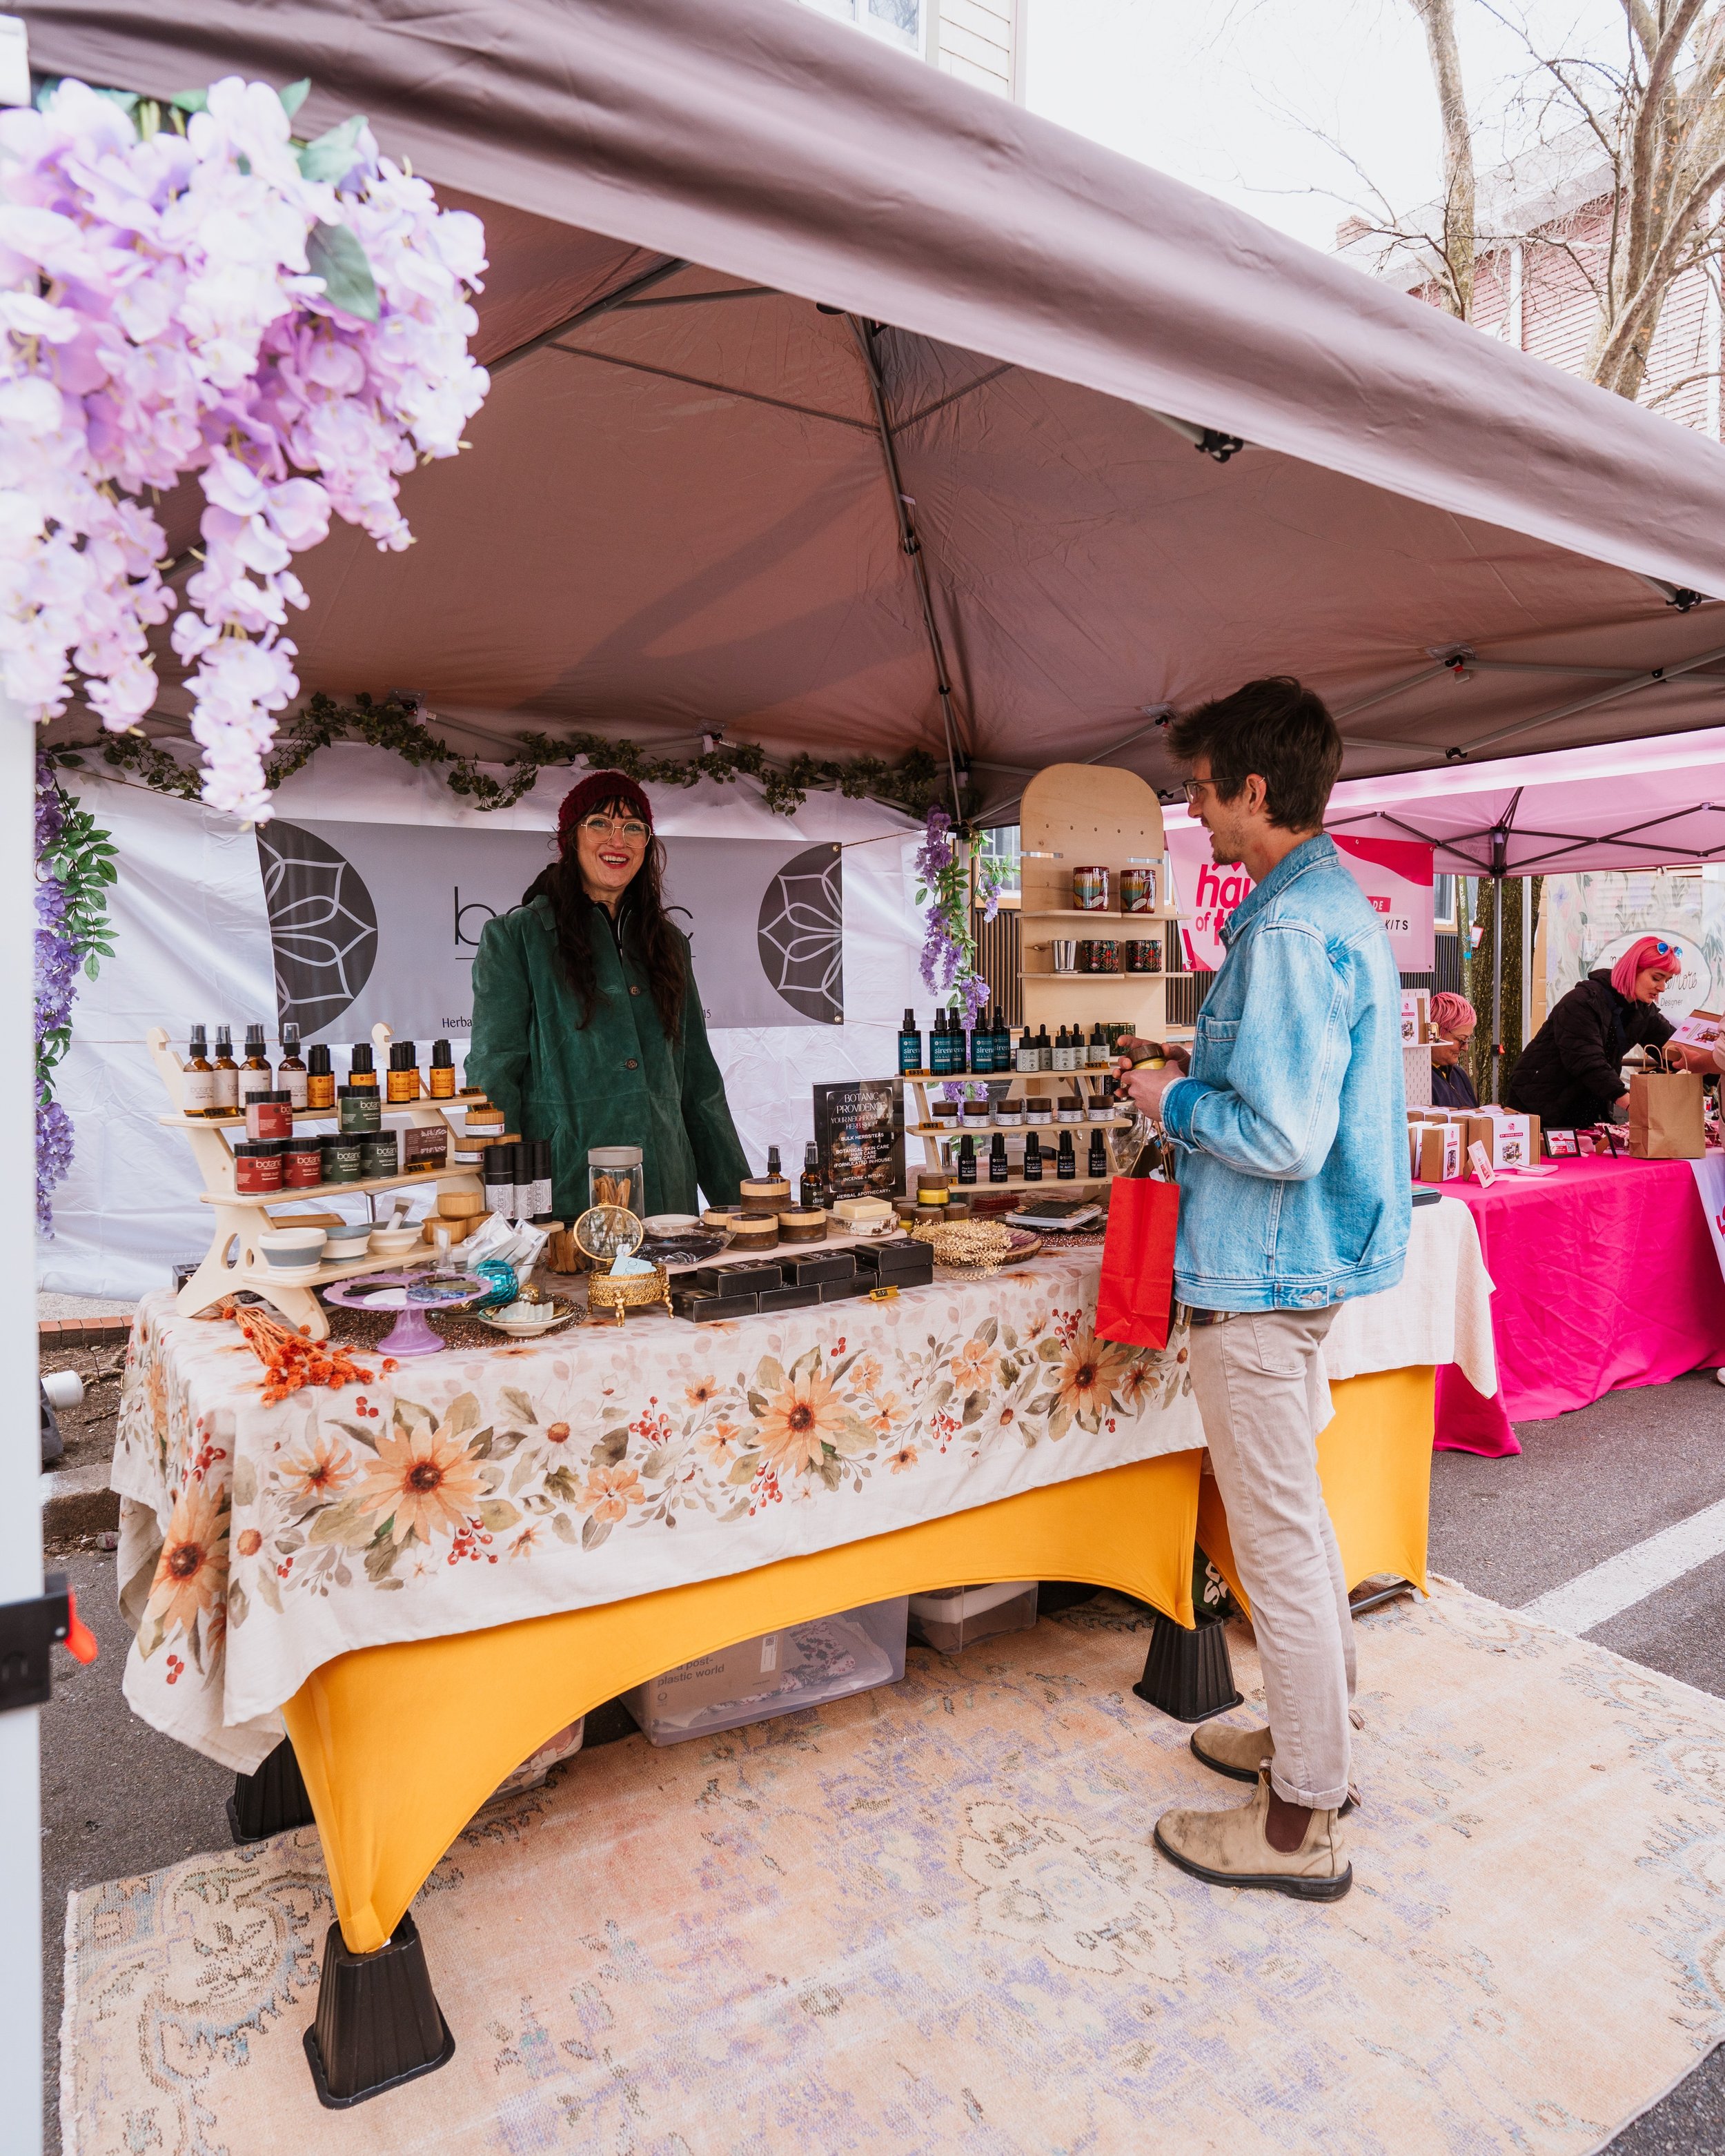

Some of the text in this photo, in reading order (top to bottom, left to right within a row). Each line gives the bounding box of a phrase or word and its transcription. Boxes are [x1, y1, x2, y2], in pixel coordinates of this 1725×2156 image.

[1195, 911, 1212, 932] of
[1384, 919, 1408, 931] KITS
[442, 1016, 472, 1029] Herba
[844, 1092, 879, 1103] BOTANIC
[836, 1102, 887, 1114] PROVIDENCE
[834, 1160, 867, 1168] (FORMULATED
[686, 1656, 713, 1670] post-
[657, 1663, 724, 1688] plastic world
